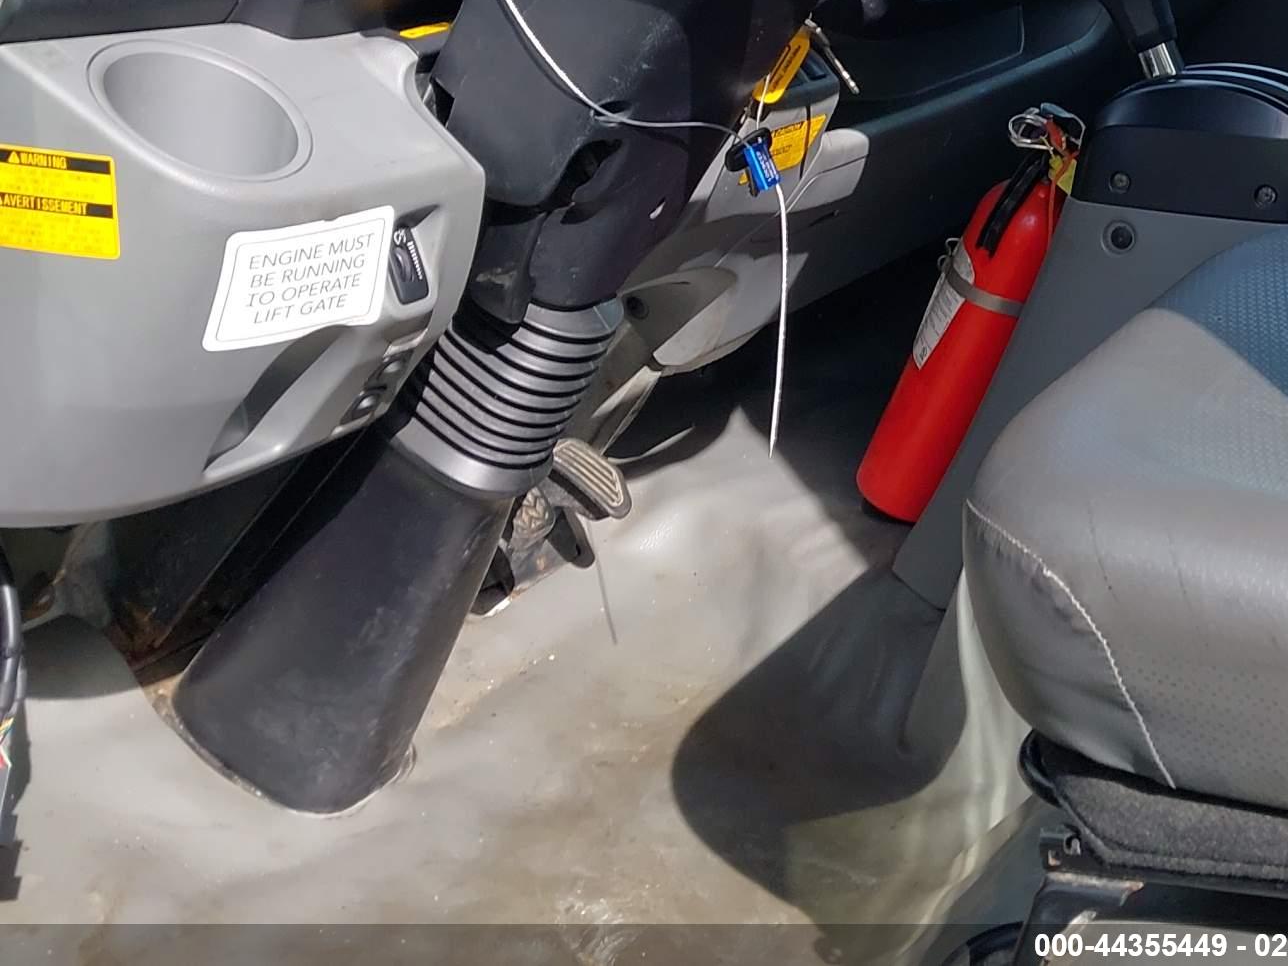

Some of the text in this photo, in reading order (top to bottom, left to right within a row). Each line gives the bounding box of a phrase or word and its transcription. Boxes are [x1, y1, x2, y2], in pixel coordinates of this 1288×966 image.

[20, 152, 67, 170] WARNING
[4, 193, 88, 216] AVERTISSEMENT
[249, 233, 375, 270] ENGINE MUST
[250, 254, 365, 289] BE RUNNING
[245, 272, 362, 308] TO OPERATE
[253, 293, 348, 324] LIFT GATE
